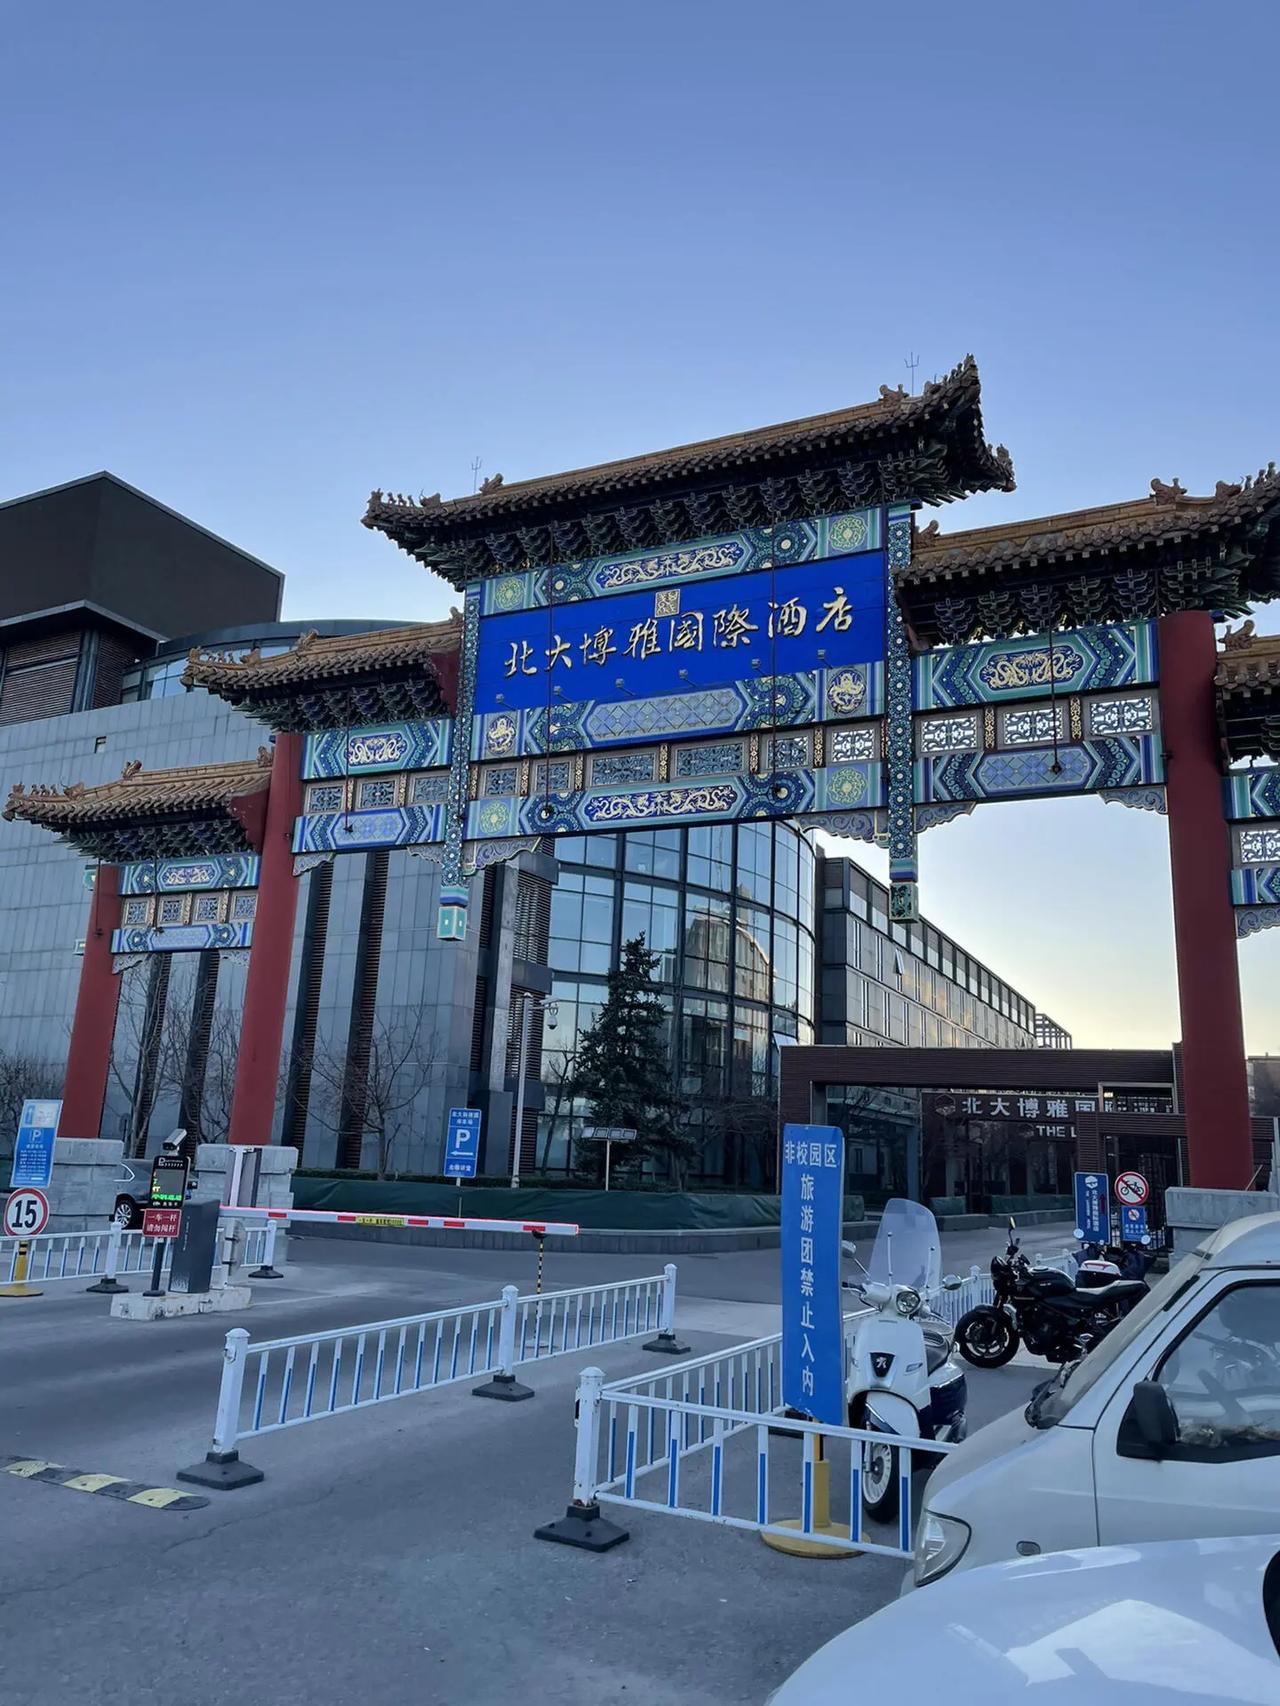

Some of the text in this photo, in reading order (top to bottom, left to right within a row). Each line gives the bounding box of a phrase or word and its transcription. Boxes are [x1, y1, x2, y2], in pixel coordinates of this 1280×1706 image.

[456, 1129, 471, 1148] P
[1035, 1125, 1066, 1137] THE
[785, 1141, 837, 1168] 非校园区
[11, 1200, 38, 1229] 15
[800, 1174, 815, 1396] 旅游团禁止入内
